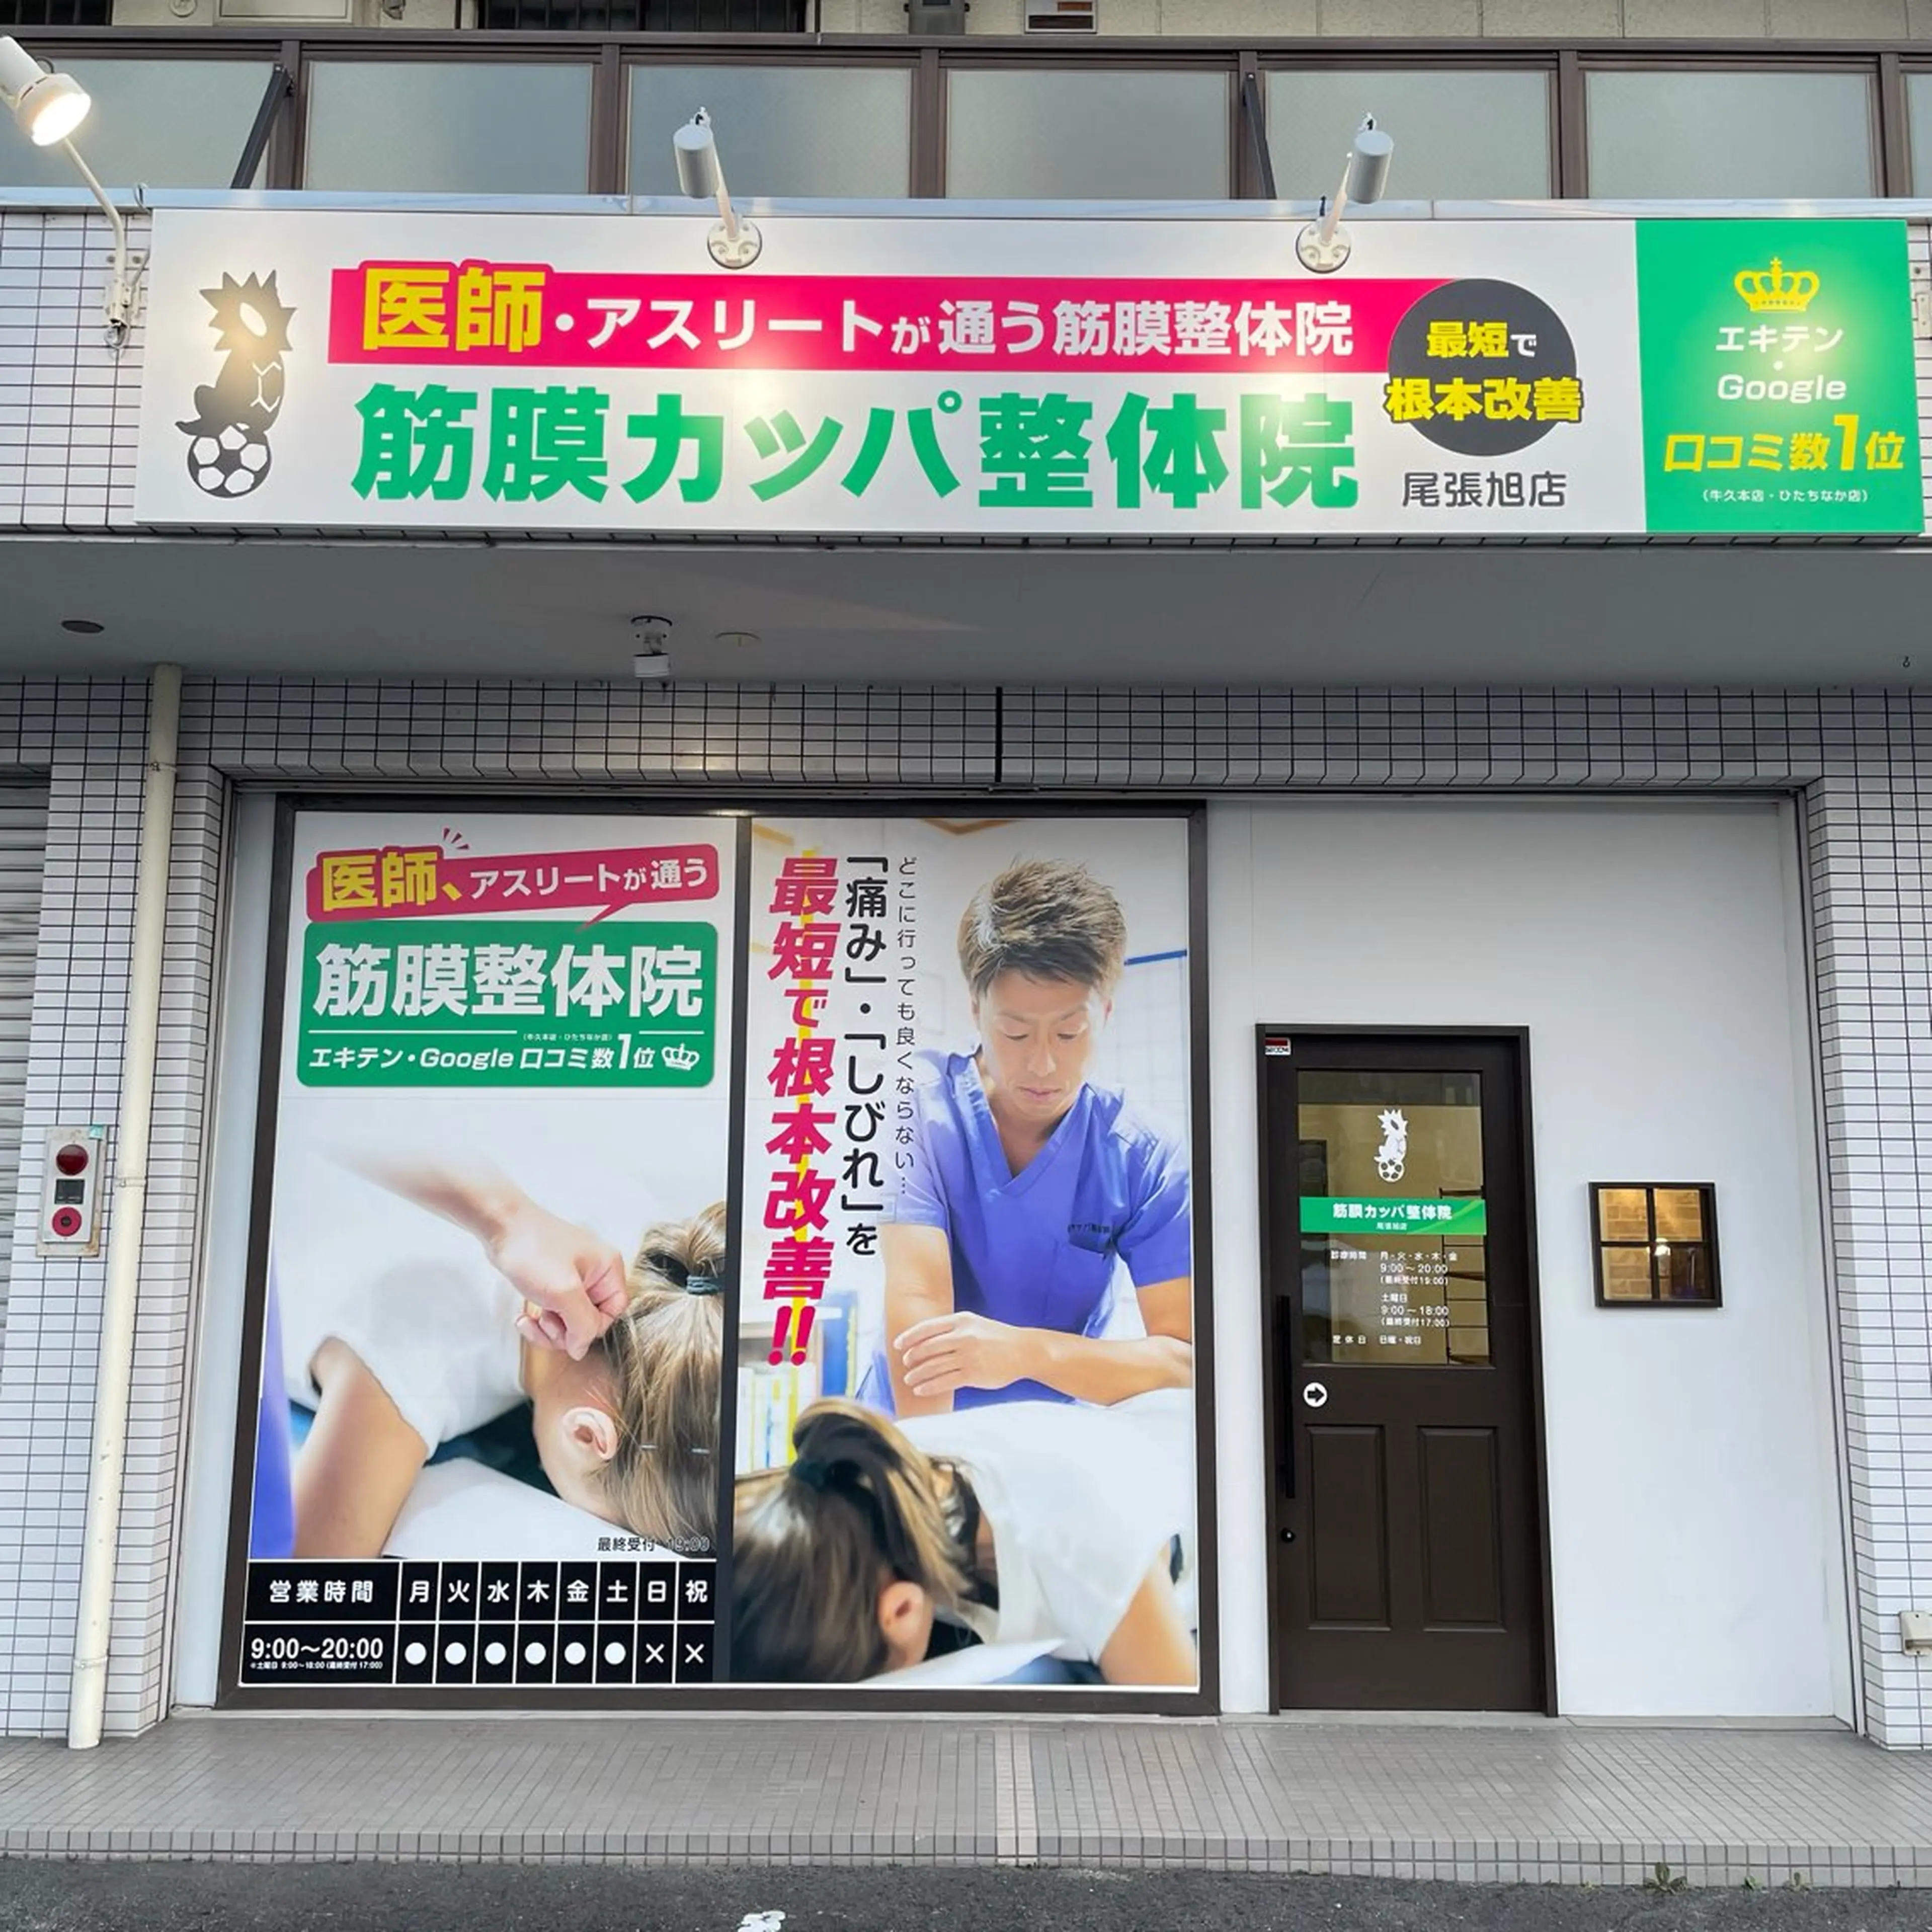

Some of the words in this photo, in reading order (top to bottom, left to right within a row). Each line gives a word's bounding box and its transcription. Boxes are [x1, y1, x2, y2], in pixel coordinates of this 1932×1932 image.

[362, 267, 1353, 357] 医師・アスリートが通う筋膜整体院
[1427, 321, 1537, 360] 最短で
[1715, 325, 1843, 354] エキテン
[1385, 377, 1582, 422] 根本改善
[1717, 373, 1847, 404] Google
[351, 382, 1358, 510] 筋膜カッパ整体院
[1663, 414, 1905, 472] 口コミ数1位
[1402, 470, 1567, 507] 尾張旭店
[321, 851, 708, 912] 医師、アスリートが通う
[312, 942, 704, 1018] 筋膜整体院
[520, 1033, 656, 1069] 口コミ数1位
[841, 857, 889, 1255] 「痛み」・「しびれ」を
[1333, 1203, 1453, 1220] 筋膜カッパ整体院
[1382, 1293, 1408, 1303] 土曜日
[598, 1537, 655, 1552] 最終受付
[269, 1579, 374, 1603] 営業時間
[409, 1580, 429, 1603] 月
[447, 1580, 470, 1603] 火
[487, 1580, 510, 1603] 水
[526, 1580, 550, 1603] 木
[566, 1580, 590, 1603] 金
[606, 1580, 629, 1603] 土
[648, 1580, 667, 1603] 日
[685, 1580, 708, 1603] 祝
